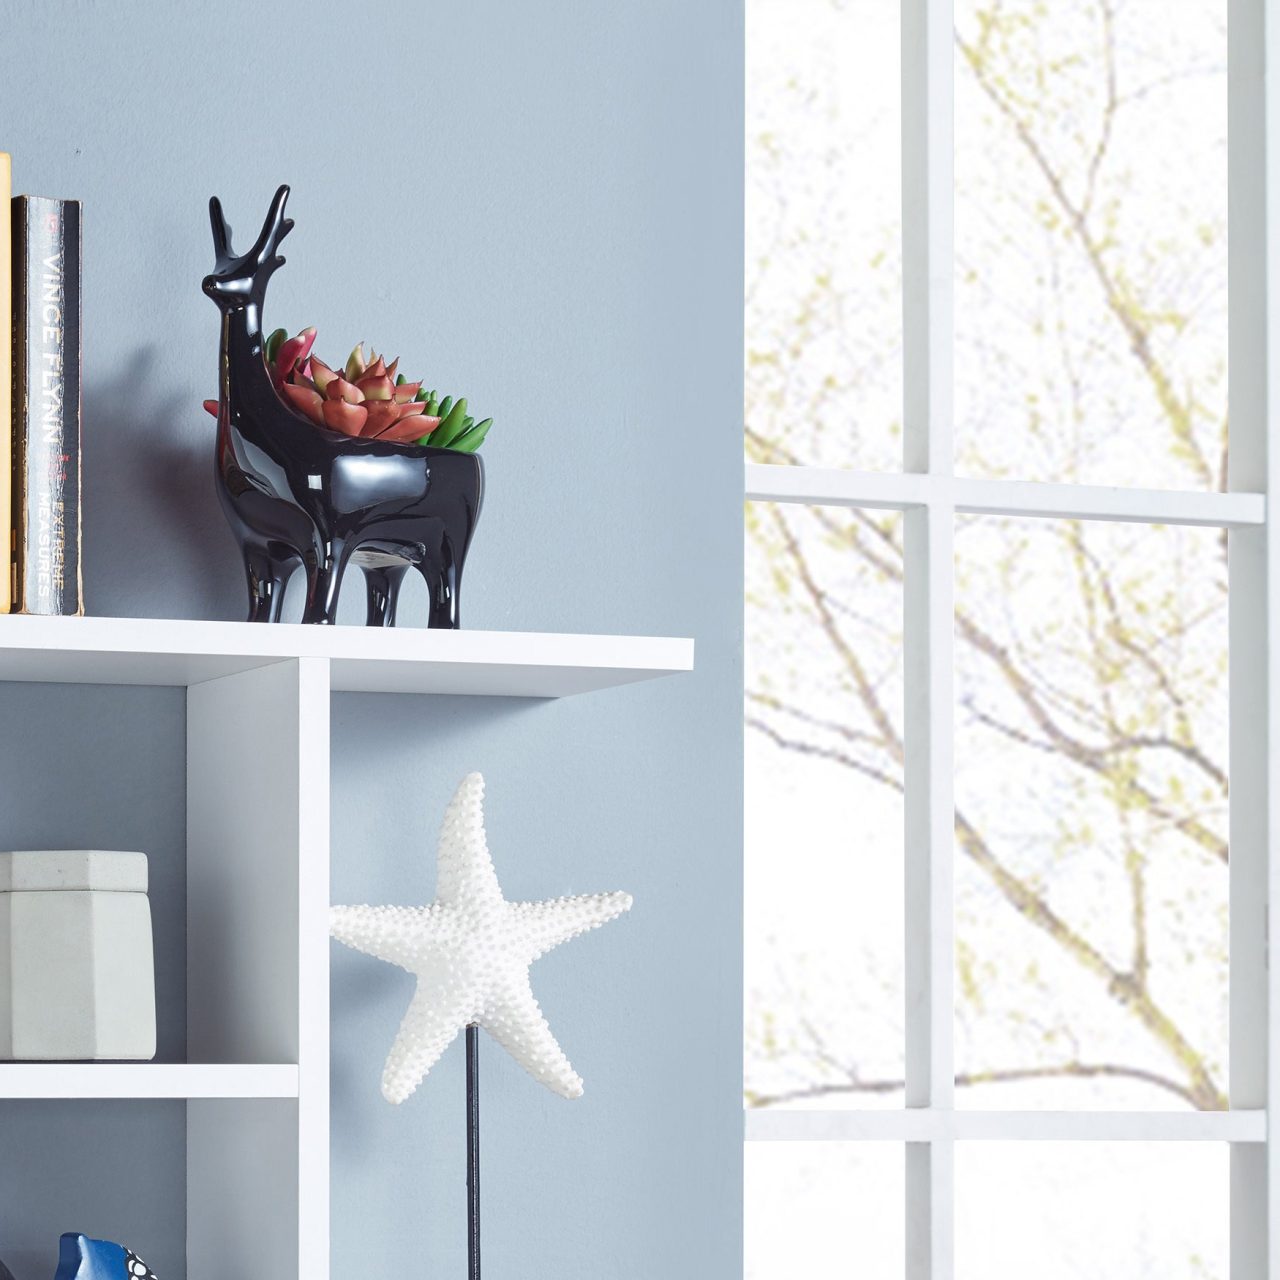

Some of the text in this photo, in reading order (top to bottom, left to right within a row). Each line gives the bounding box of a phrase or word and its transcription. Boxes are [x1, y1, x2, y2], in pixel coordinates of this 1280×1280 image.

[42, 253, 62, 344] VINCE
[42, 353, 62, 443] FLYNN
[38, 492, 51, 597] MEASURES
